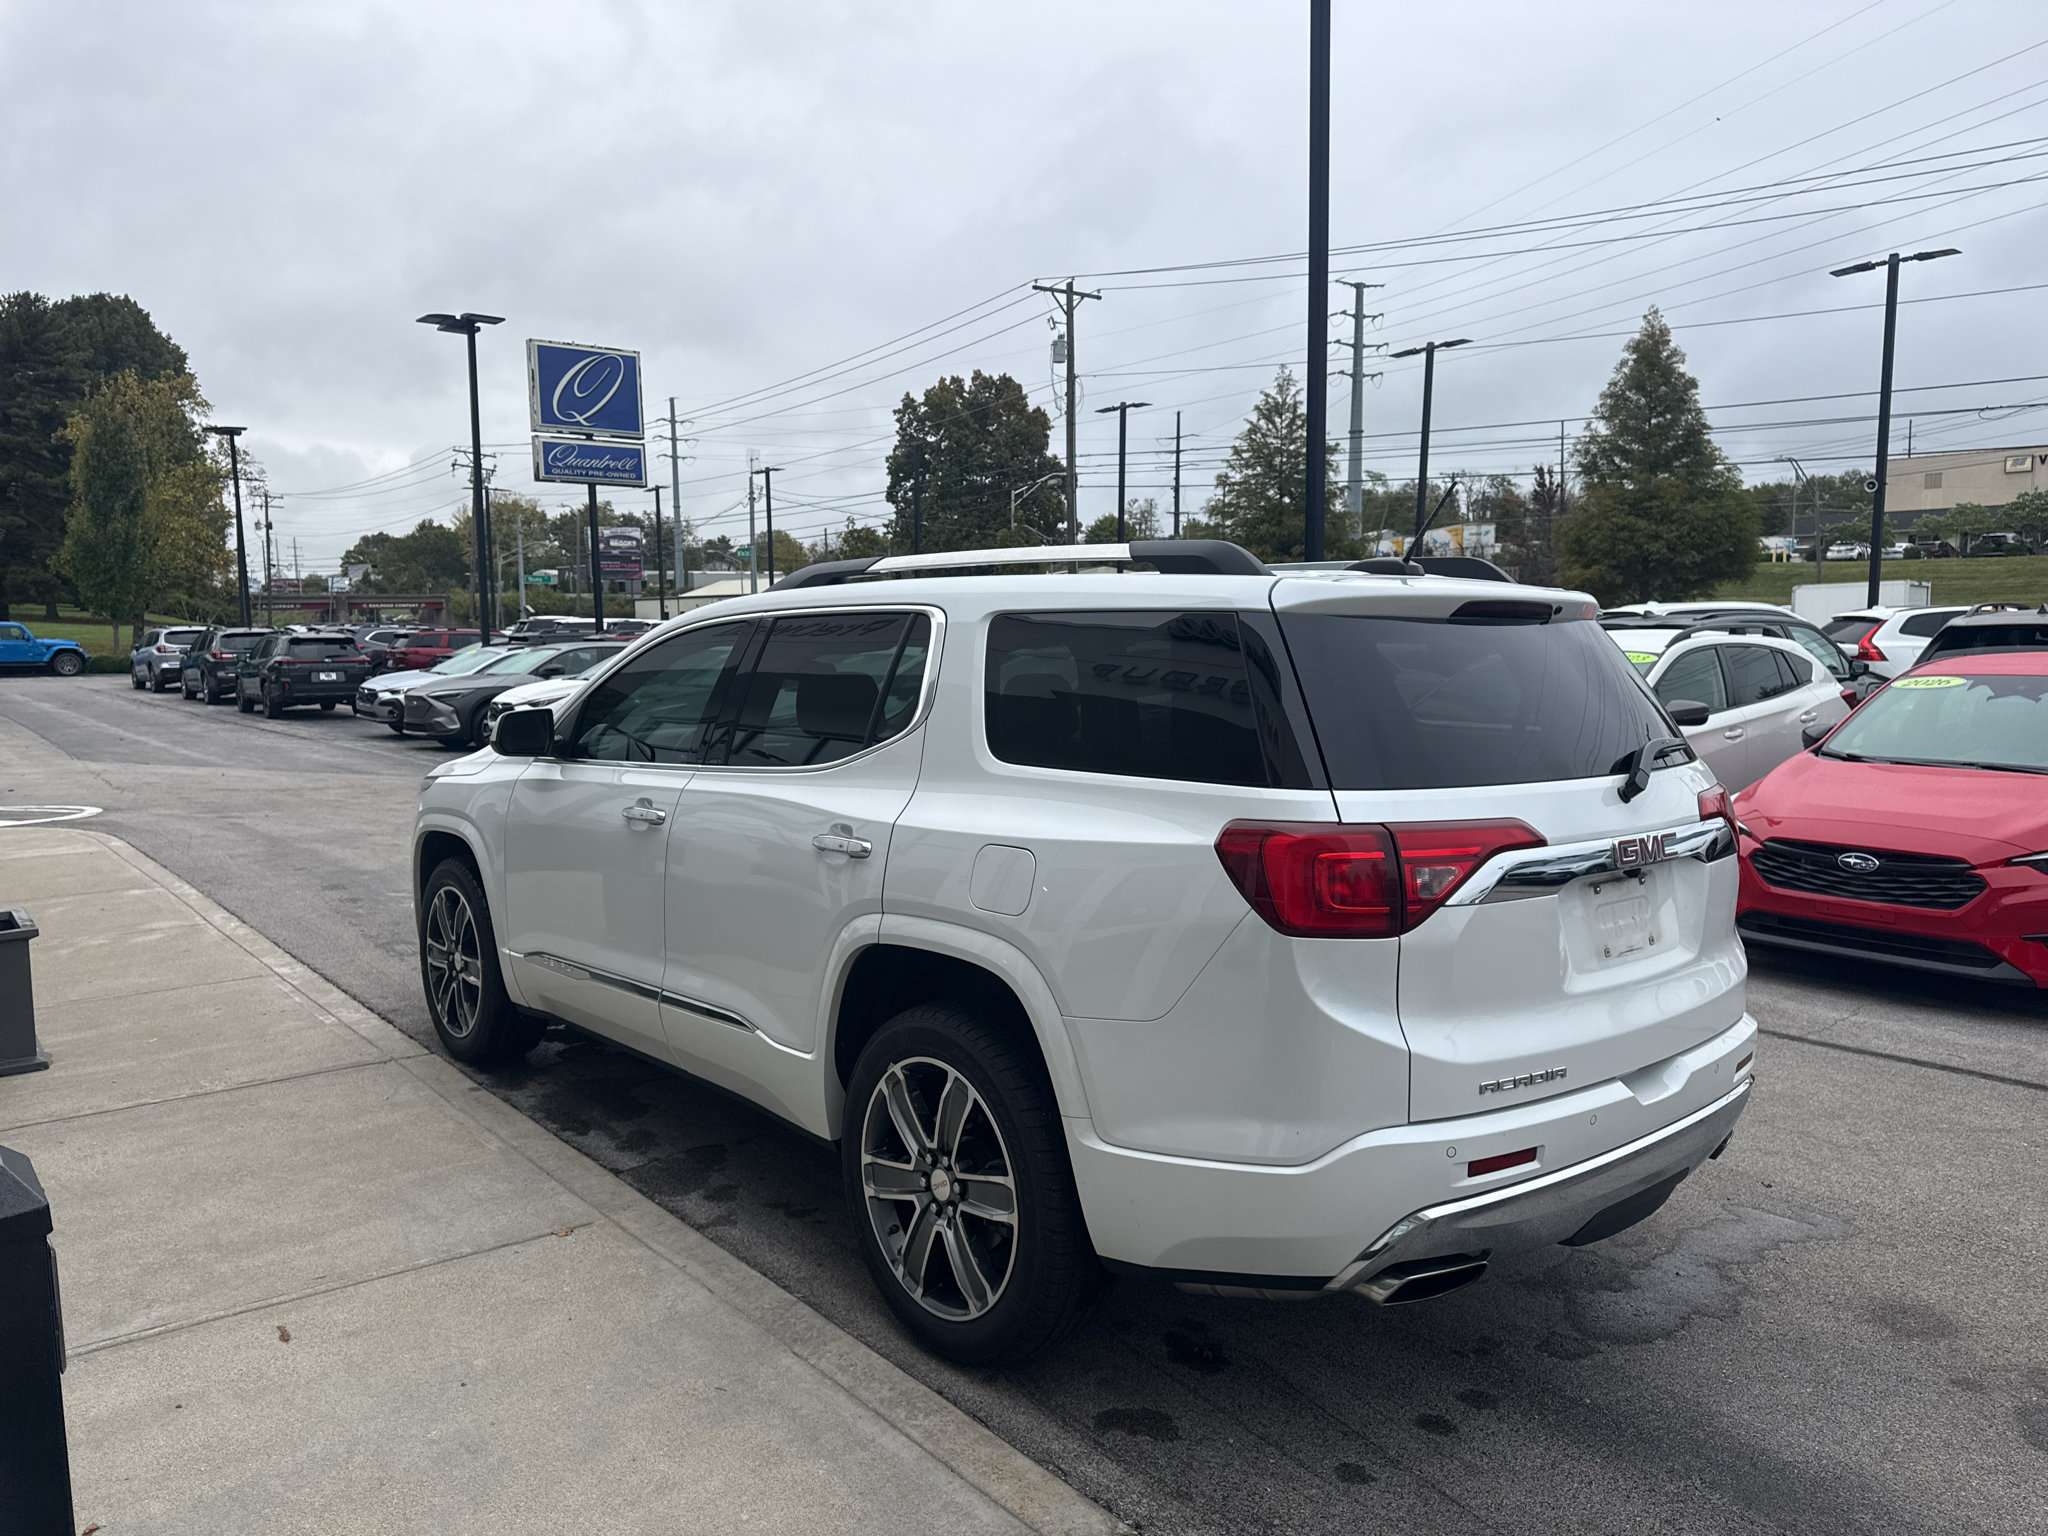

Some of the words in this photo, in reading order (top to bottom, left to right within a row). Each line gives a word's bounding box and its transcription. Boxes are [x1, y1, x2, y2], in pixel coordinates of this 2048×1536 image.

[552, 354, 624, 426] Q
[547, 444, 638, 471] Quantrell
[551, 467, 587, 476] QUALITY
[588, 469, 636, 479] PRE-OWNED
[1617, 831, 1679, 865] GMC
[1479, 1066, 1567, 1095] ACADIA
